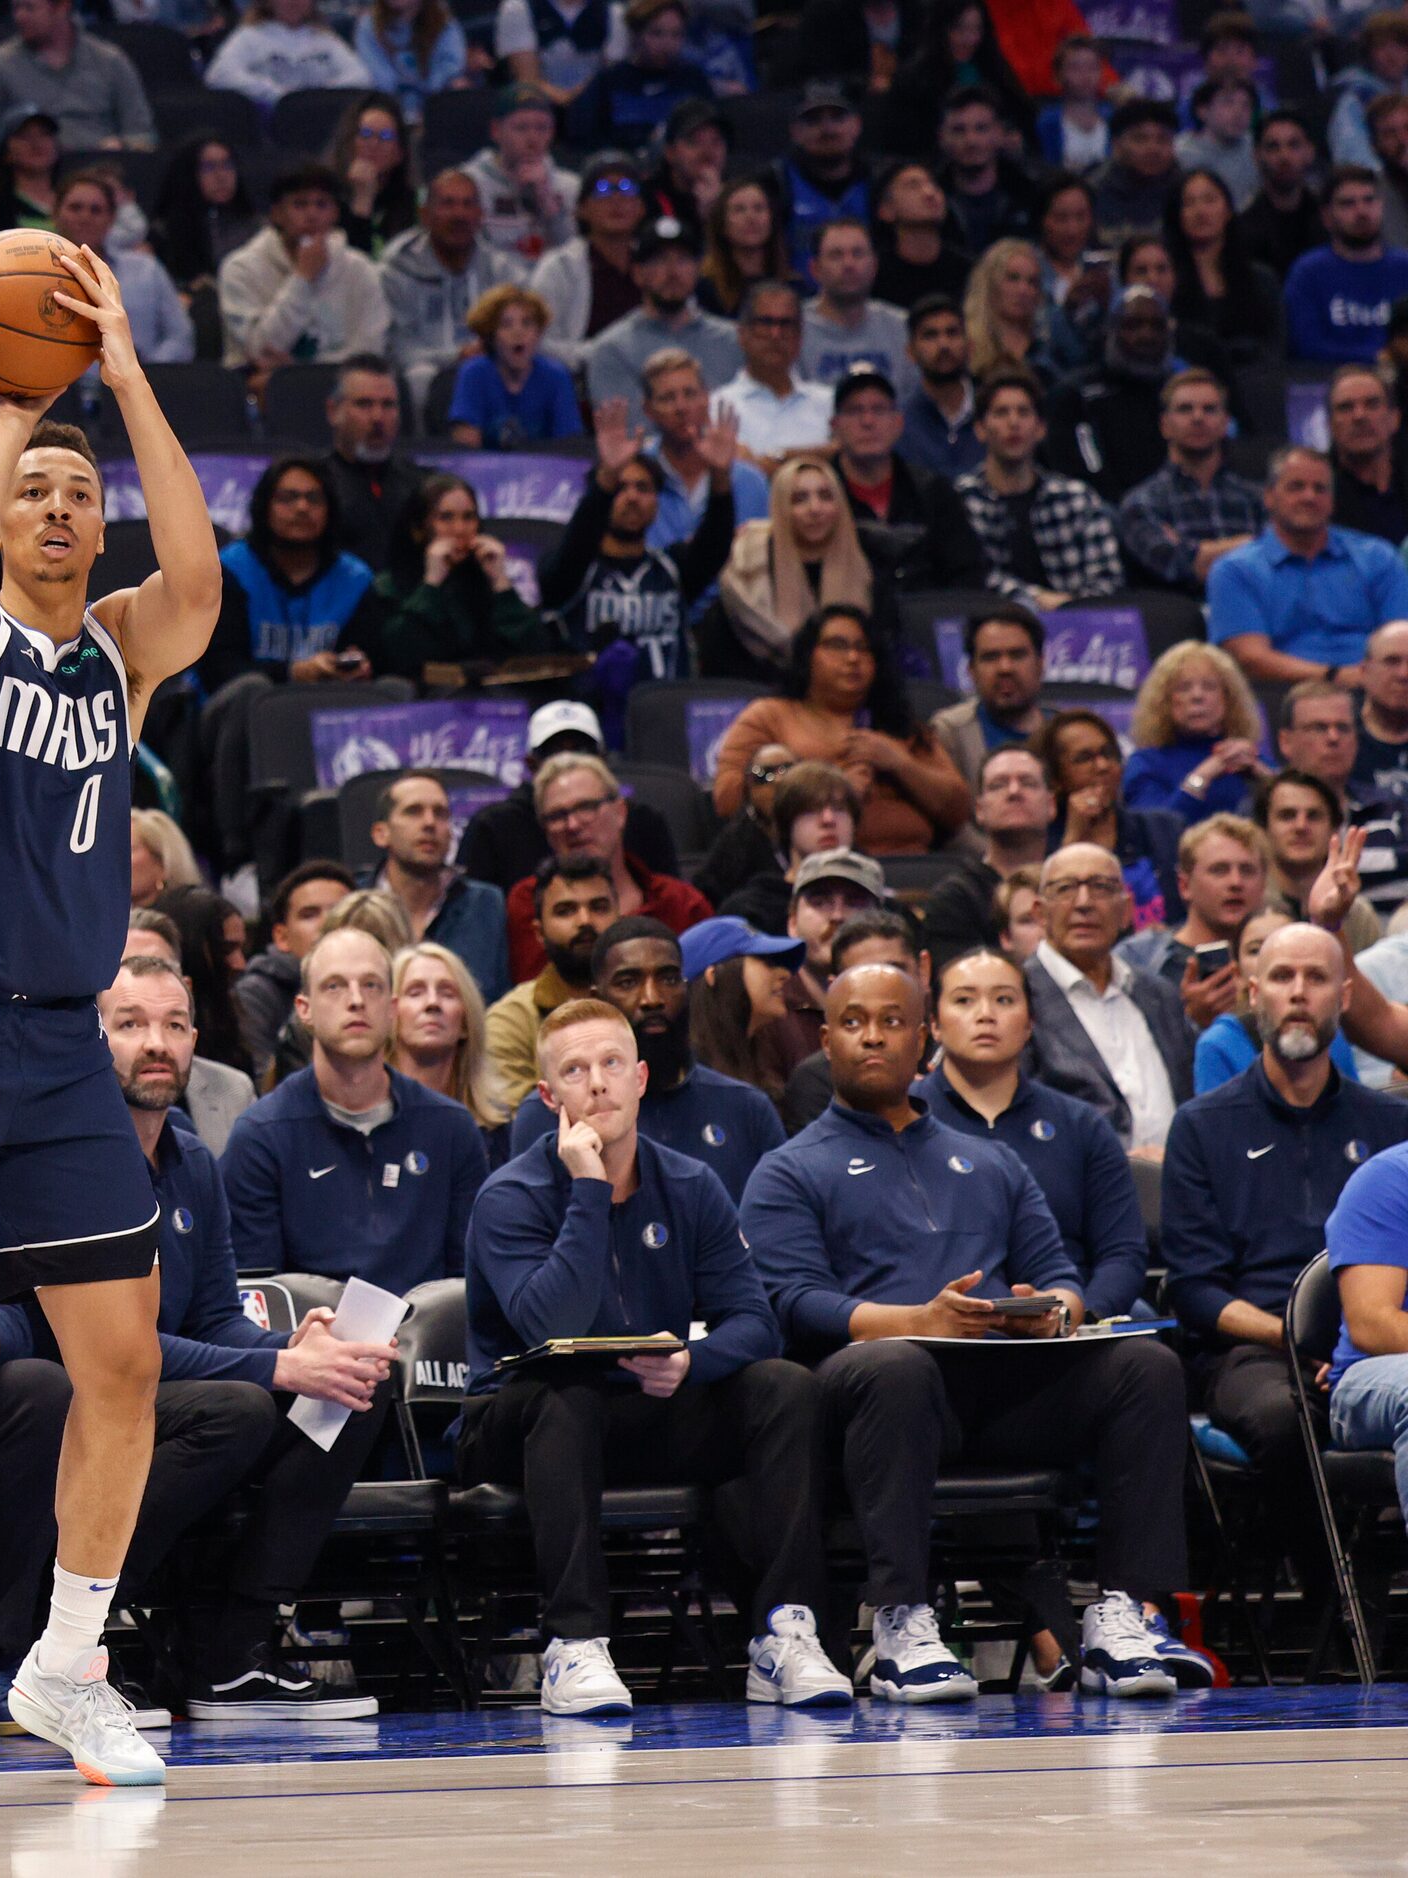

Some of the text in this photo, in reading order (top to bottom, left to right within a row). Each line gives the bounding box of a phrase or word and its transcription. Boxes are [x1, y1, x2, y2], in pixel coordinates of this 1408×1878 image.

[69, 774, 103, 854] 0
[415, 1360, 471, 1389] ALL AC
